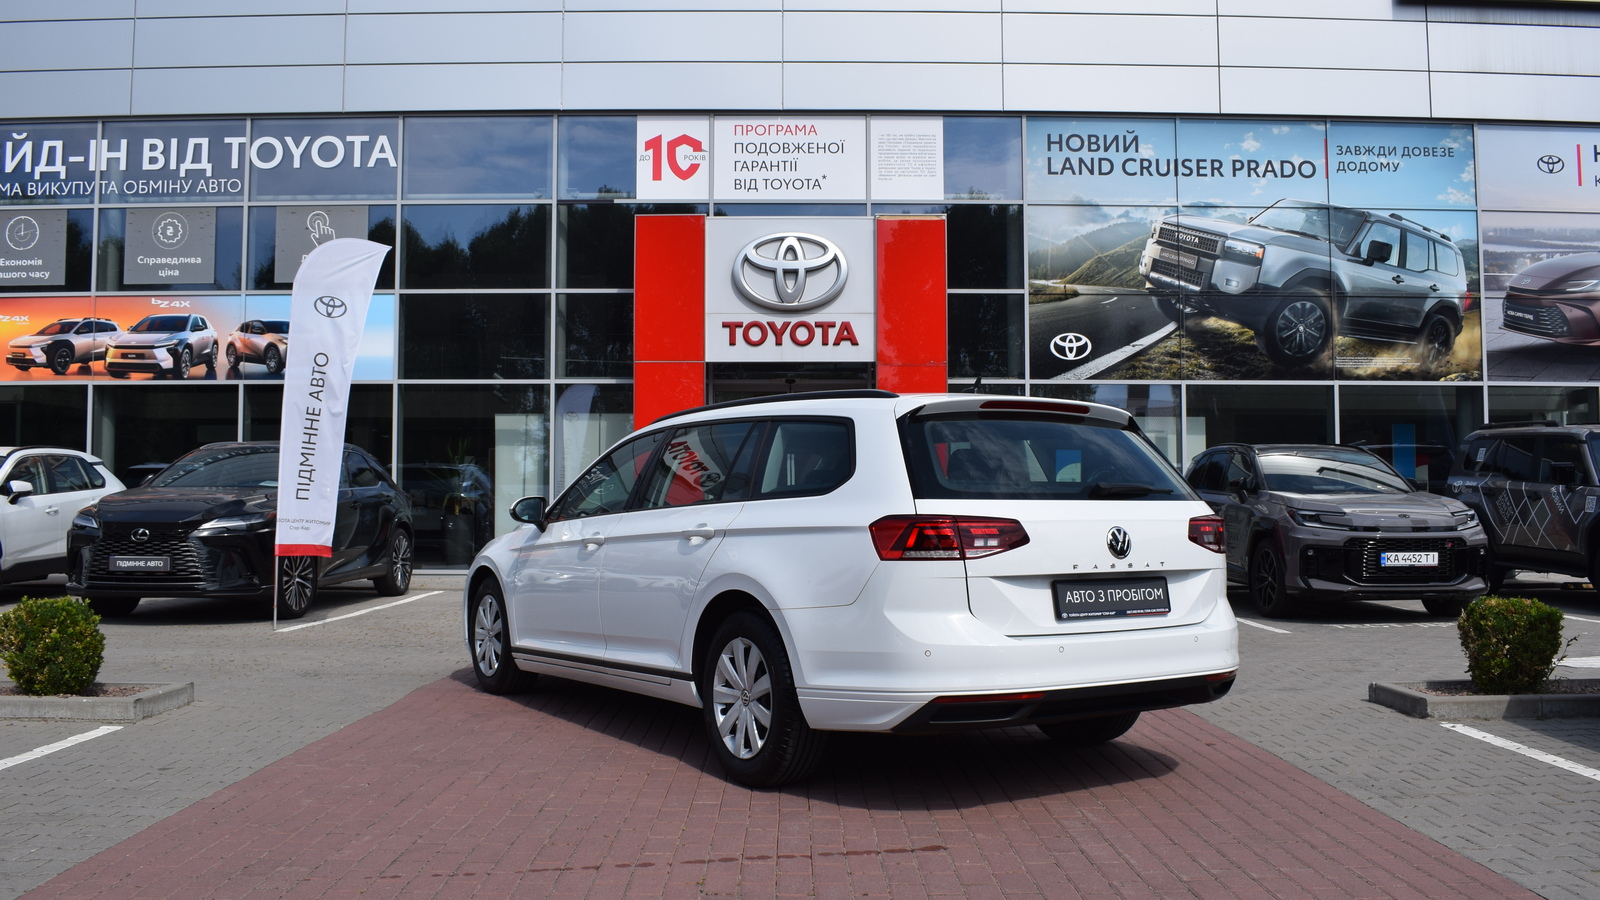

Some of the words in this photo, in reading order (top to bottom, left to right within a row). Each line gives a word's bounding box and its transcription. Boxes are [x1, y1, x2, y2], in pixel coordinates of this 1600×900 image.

[734, 124, 818, 136] ПРОГРАМА
[734, 139, 846, 156] ПОДОВЖЕНОЇ
[1046, 130, 1140, 153] НОВИЙ
[142, 137, 213, 177] ВІД
[224, 135, 398, 169] TOYOTA
[639, 154, 651, 162] ДО
[1336, 145, 1397, 158] ЗАВЖДИ
[1401, 146, 1455, 159] ДОВЕЗЕ
[734, 158, 799, 172] ГАРАНТІЇ
[1046, 156, 1115, 176] LAND
[1121, 157, 1225, 178] CRUISER
[1231, 159, 1317, 179] PRADO
[1336, 161, 1400, 174] ДОДОМУ
[0, 182, 22, 196] МА
[27, 181, 96, 196] ВИКУПУ
[99, 180, 118, 194] ТА
[123, 179, 192, 194] ОБМІНУ
[196, 178, 242, 193] АВТО
[734, 178, 758, 192] ВІД
[1174, 232, 1199, 244] TOYOTA
[0, 258, 42, 266] Економія
[137, 256, 202, 266] Справедлива
[28, 272, 50, 280] часу
[158, 268, 180, 278] ціна
[722, 320, 859, 346] TOYOTA
[308, 352, 330, 402] АВТО
[296, 406, 322, 500] ПІДМІННЕ
[116, 560, 146, 568] ПІДМІННЕ
[1386, 554, 1400, 563] KA
[1401, 554, 1422, 563] 4452
[1065, 590, 1096, 604] АВТО
[1107, 588, 1164, 602] ПРОБІГОМ
